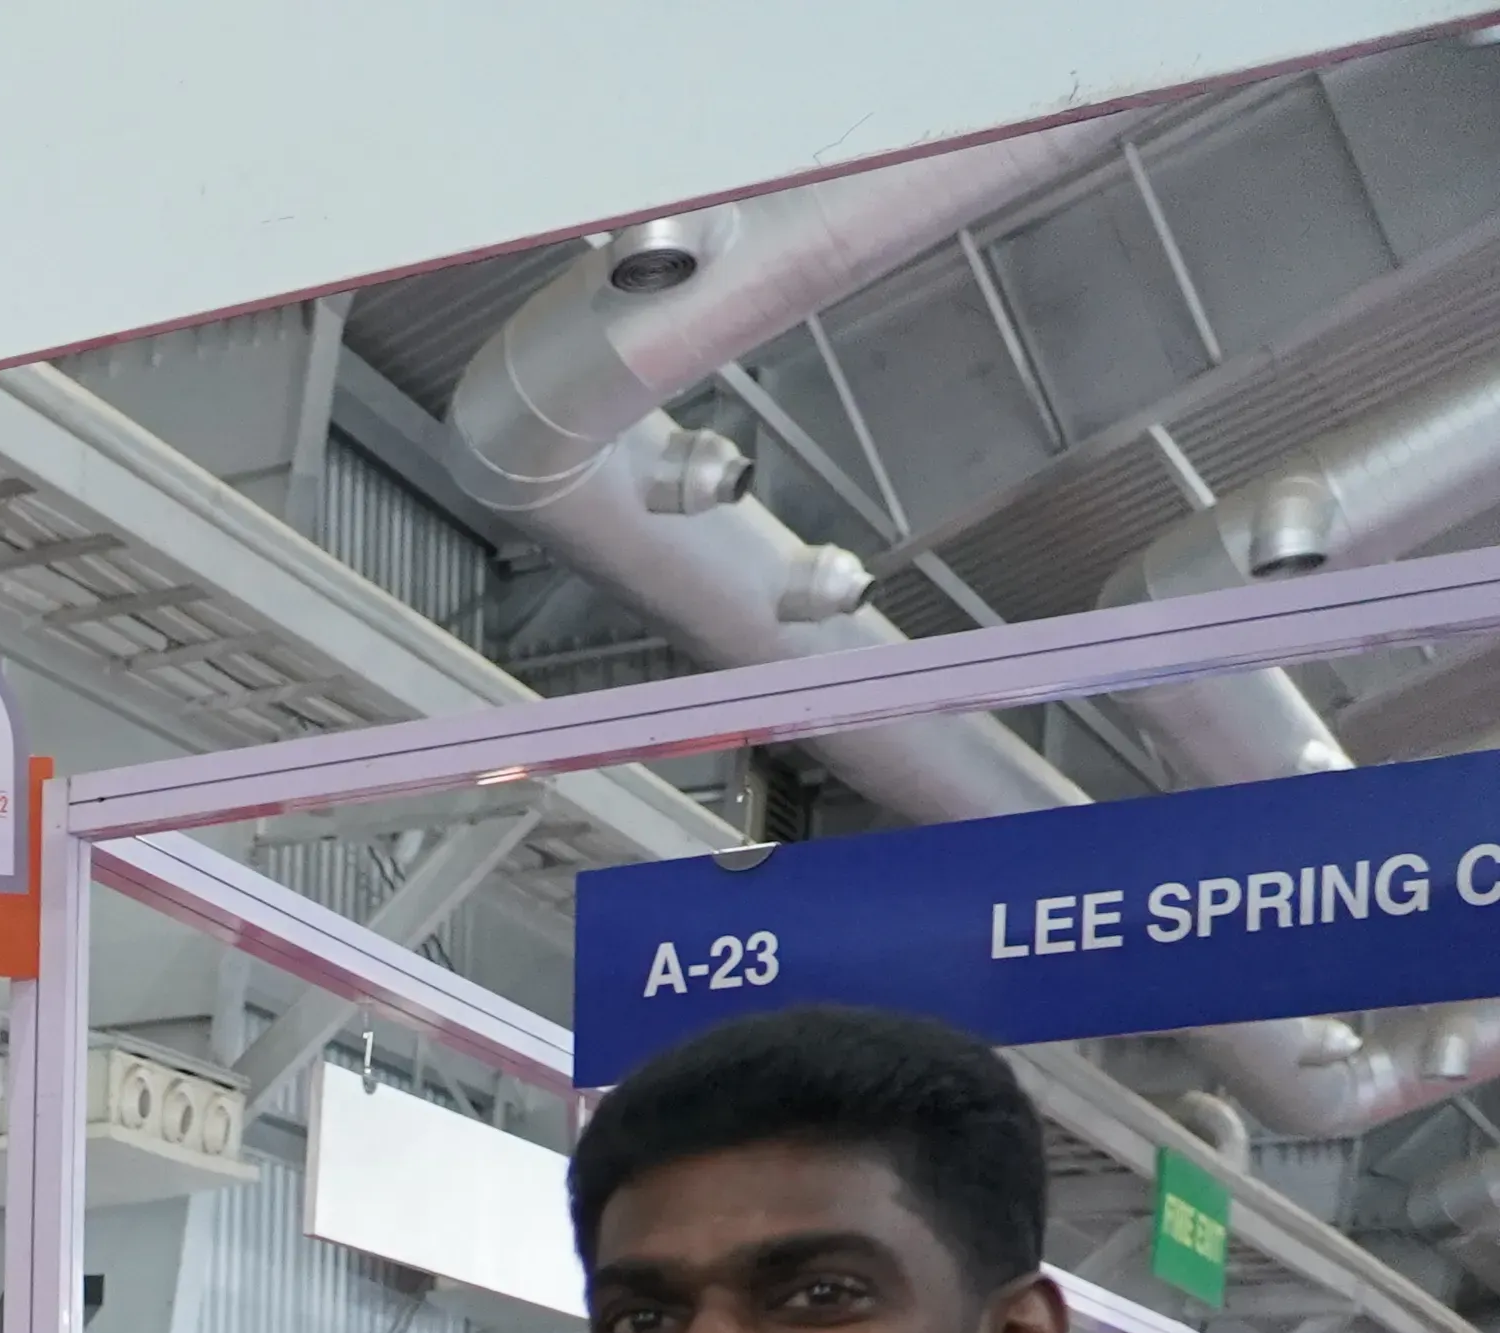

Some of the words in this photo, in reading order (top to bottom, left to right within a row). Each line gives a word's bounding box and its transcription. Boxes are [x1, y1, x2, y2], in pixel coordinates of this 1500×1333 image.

[643, 929, 780, 999] A-23
[991, 889, 1124, 961] LEE
[1146, 852, 1429, 945] SPRING
